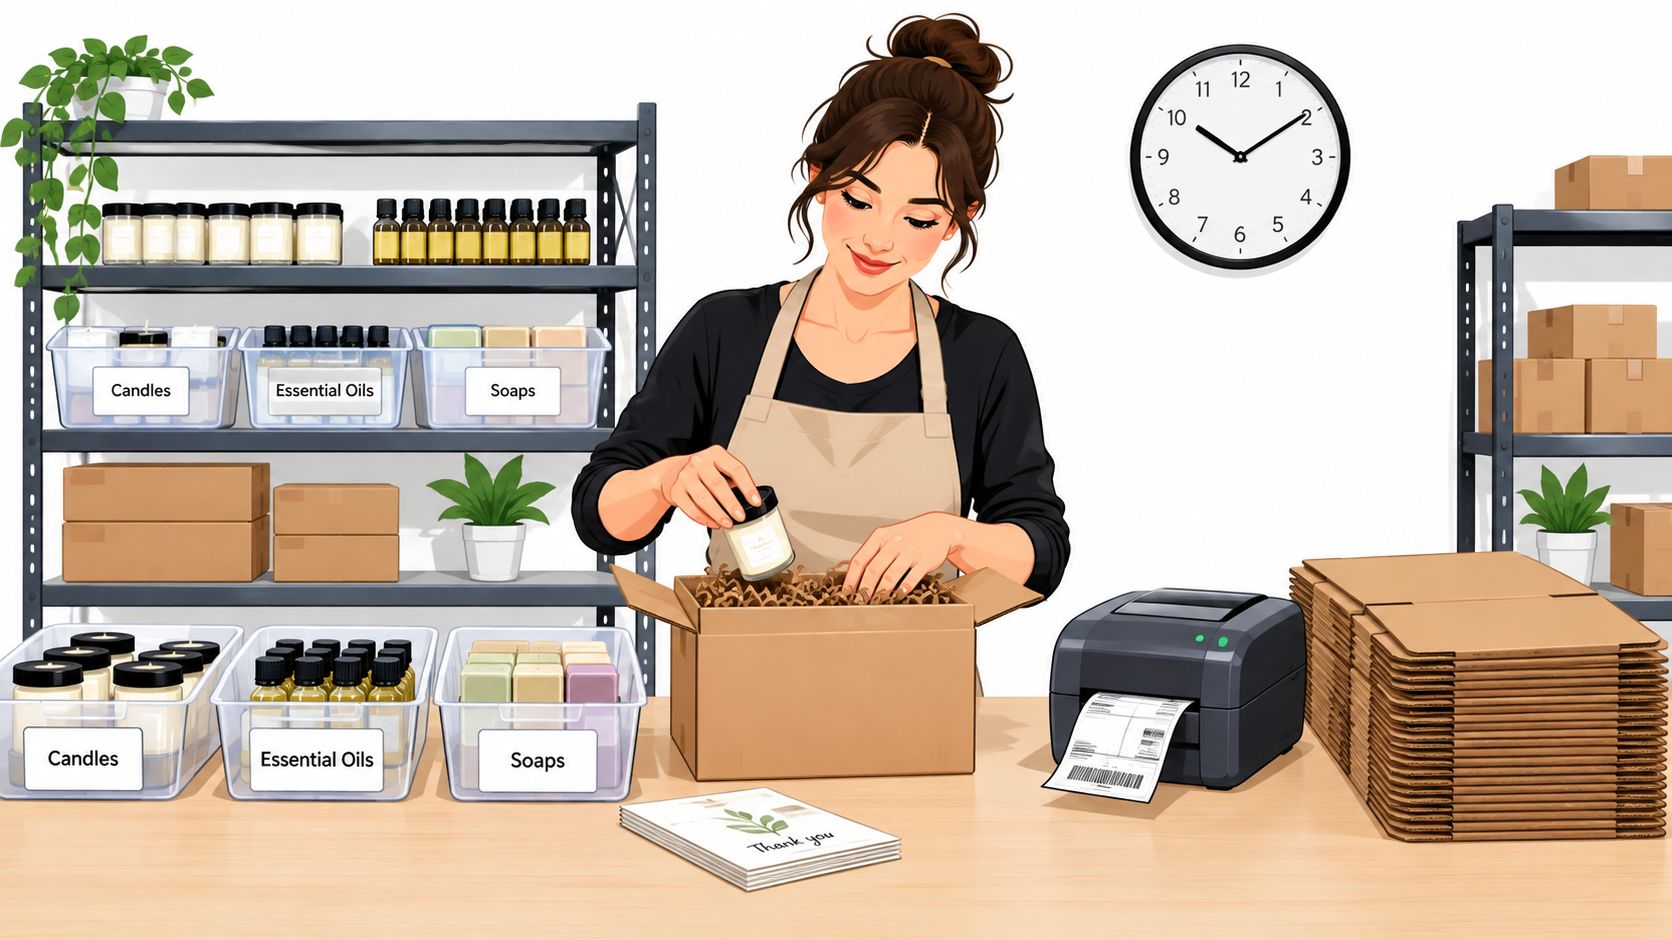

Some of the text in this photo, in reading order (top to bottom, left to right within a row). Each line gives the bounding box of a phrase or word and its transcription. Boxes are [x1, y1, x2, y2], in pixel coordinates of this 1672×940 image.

[1231, 71, 1251, 88] 12
[1195, 80, 1210, 98] 11
[1275, 80, 1282, 98] 1
[1167, 109, 1187, 126] 10
[1301, 109, 1312, 126] 2
[1157, 148, 1170, 166] 9
[1311, 148, 1323, 166] 3
[1168, 188, 1180, 206] 8
[1300, 188, 1312, 205] 4
[1197, 216, 1209, 233] 7
[1272, 216, 1284, 233] 5
[1234, 225, 1246, 243] 6
[111, 383, 171, 397] Candles
[276, 383, 374, 397] Essential Oils
[490, 383, 536, 401] Soaps
[47, 749, 119, 767] Candles
[261, 750, 374, 768] Essential Oils
[510, 751, 566, 773] Soaps
[747, 832, 835, 853] Thank you
